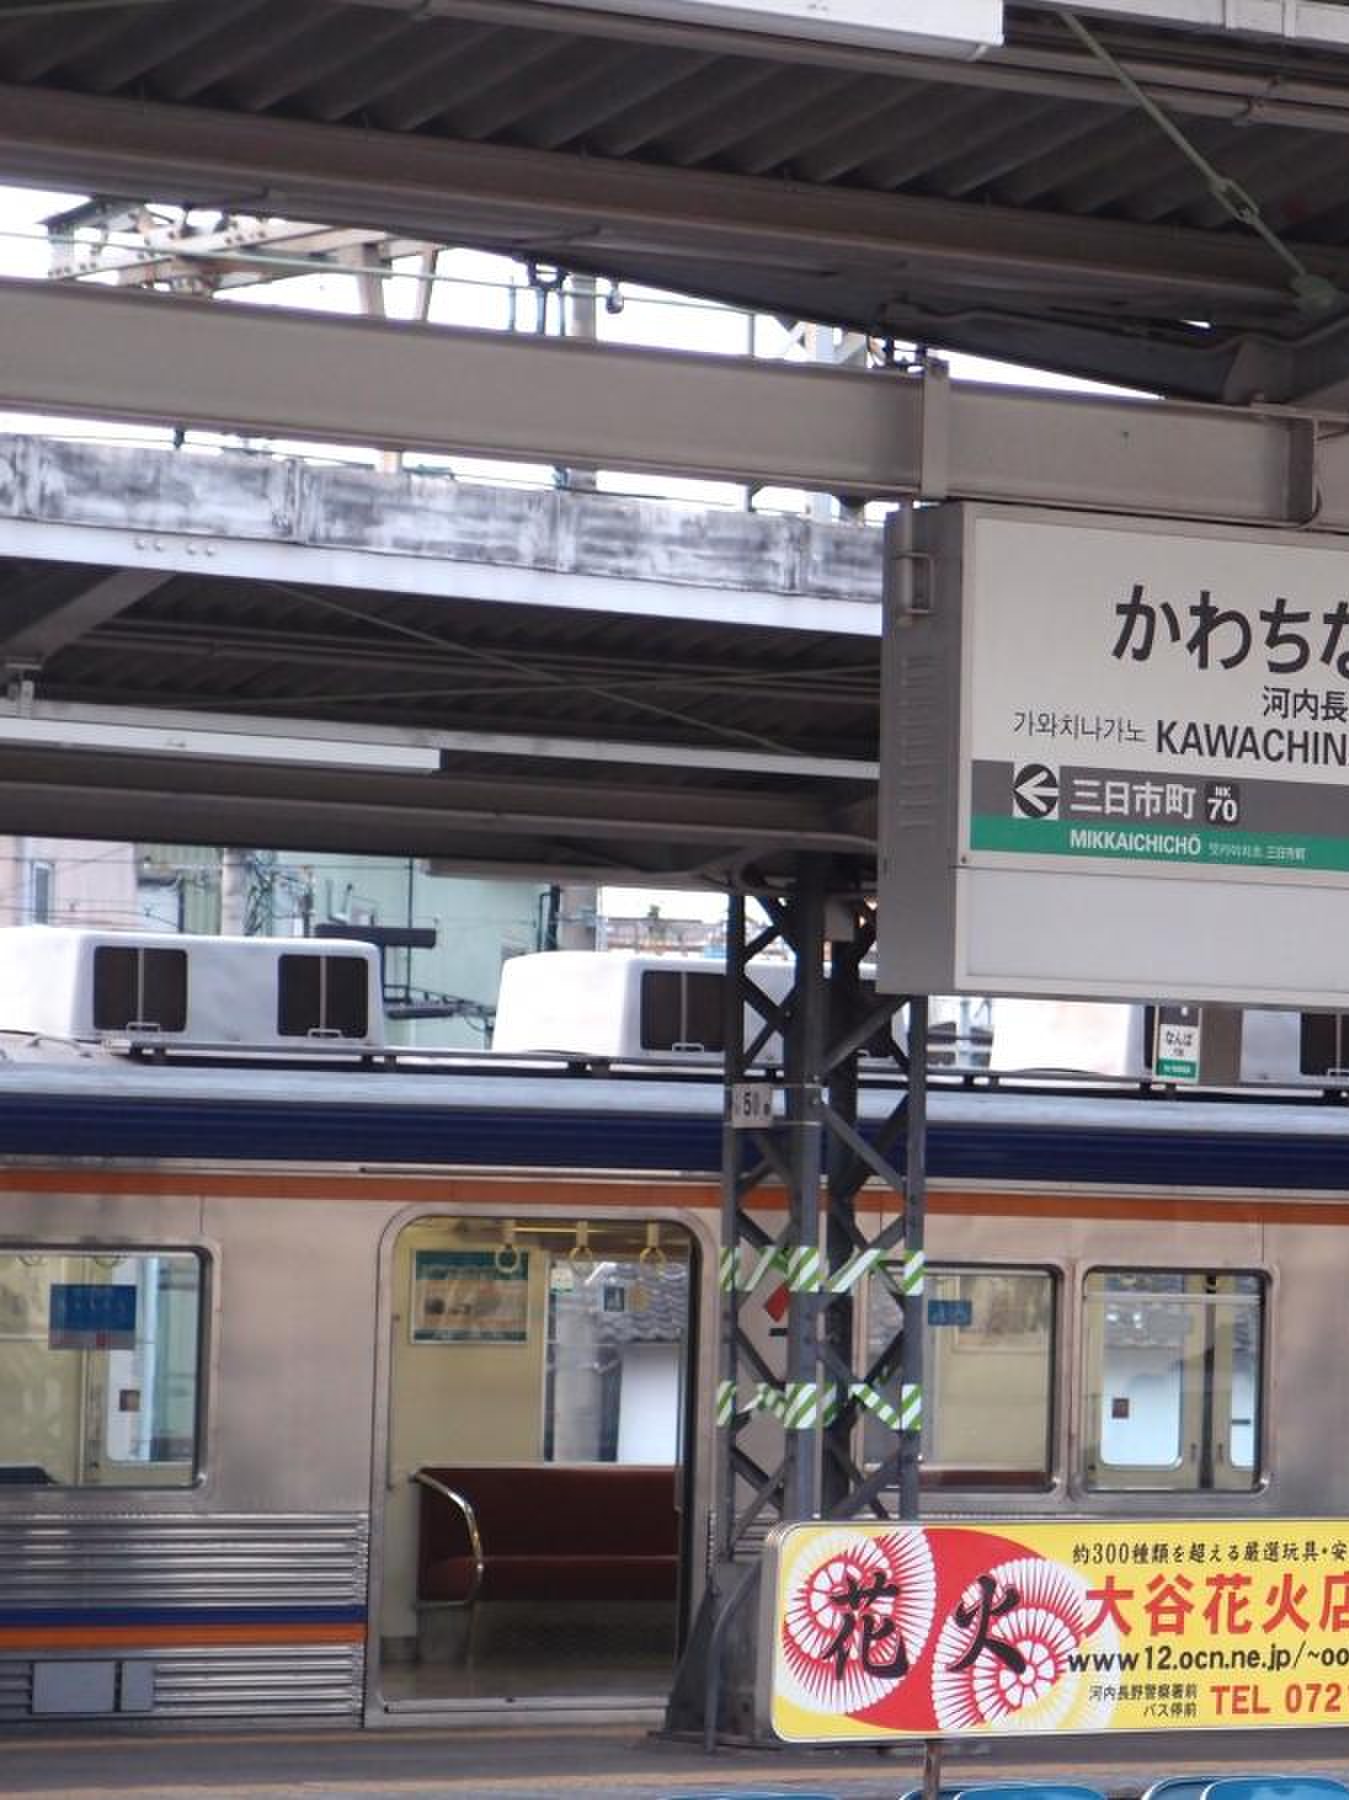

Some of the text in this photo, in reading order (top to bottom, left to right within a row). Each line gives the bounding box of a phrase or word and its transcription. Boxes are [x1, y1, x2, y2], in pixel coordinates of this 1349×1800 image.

[1013, 711, 1147, 743] 가와치나가노
[1069, 779, 1196, 820] 三日市町
[1207, 799, 1238, 823] 70
[1143, 1702, 1198, 1718] バス停前
[1210, 1684, 1271, 1716] TEL
